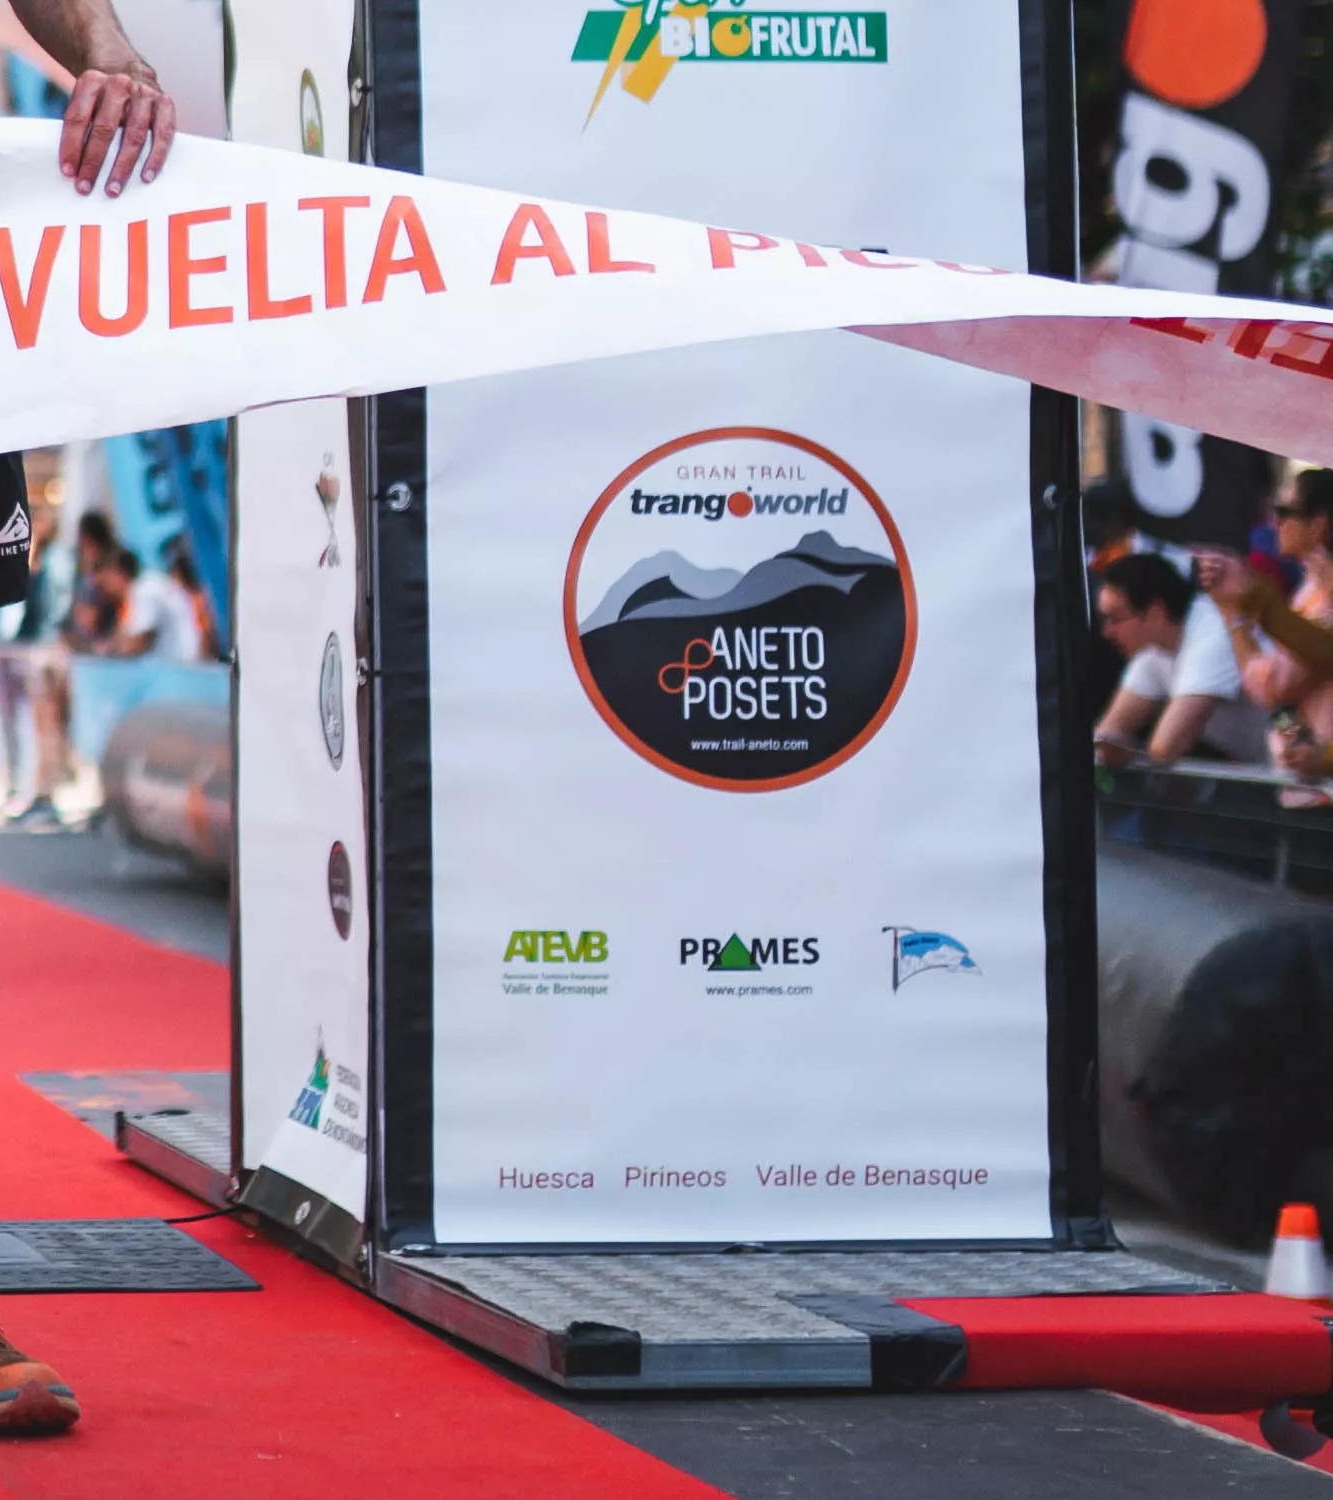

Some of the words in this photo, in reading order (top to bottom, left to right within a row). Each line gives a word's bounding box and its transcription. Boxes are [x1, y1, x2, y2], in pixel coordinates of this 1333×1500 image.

[489, 202, 656, 286] AL
[677, 465, 736, 481] GRAN
[747, 465, 805, 481] TRAIL
[711, 626, 825, 671] ANETO
[683, 676, 827, 720] POSETS
[690, 736, 809, 752] www.trail-aneto.com
[502, 983, 531, 996] Valle
[536, 983, 550, 996] de
[553, 983, 609, 998] Benasque
[705, 984, 813, 997] www.prames.com
[498, 1166, 595, 1190] Huesca
[624, 1166, 726, 1190] Pirineos
[756, 1165, 818, 1188] Valle
[825, 1165, 856, 1188] de
[864, 1164, 989, 1191] Benasque
